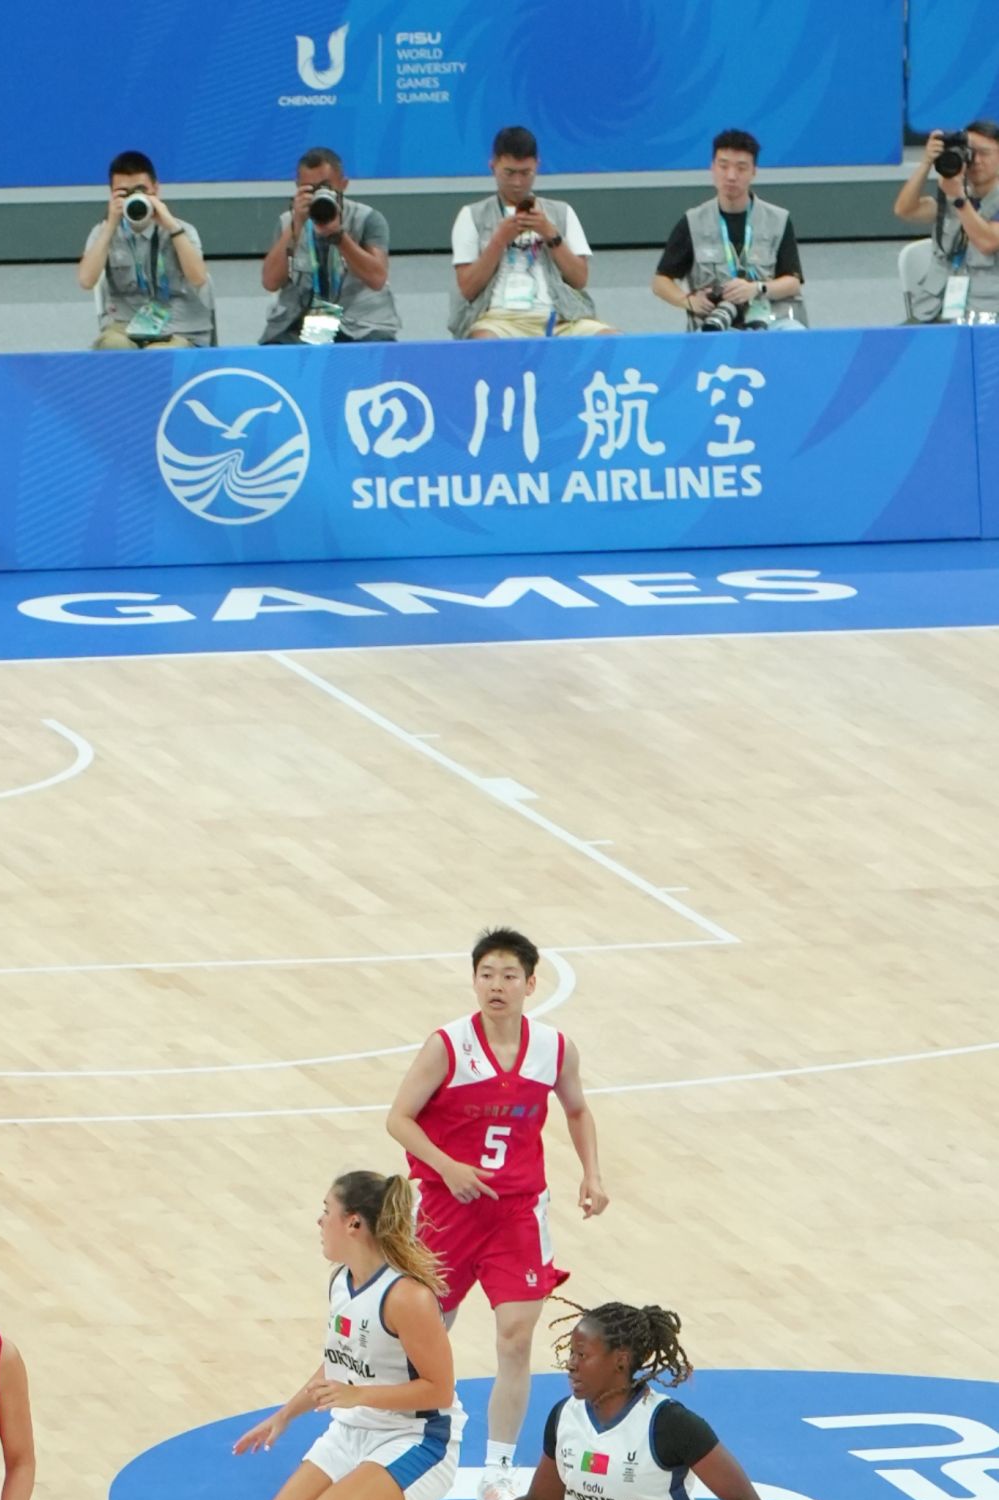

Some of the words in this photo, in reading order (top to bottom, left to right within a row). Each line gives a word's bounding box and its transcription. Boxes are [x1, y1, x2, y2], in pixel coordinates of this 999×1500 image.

[396, 32, 441, 44] FISU
[397, 48, 443, 60] WORLD
[396, 62, 467, 75] UNIVERSITY
[396, 77, 439, 89] GAMES
[278, 95, 337, 106] CHENGDU
[396, 91, 449, 104] SUMMER
[344, 364, 766, 463] 四川航空
[352, 472, 549, 509] SICHUAN
[561, 465, 763, 504] AIRLINES
[16, 569, 859, 626] GAMES
[480, 1125, 512, 1170] 5
